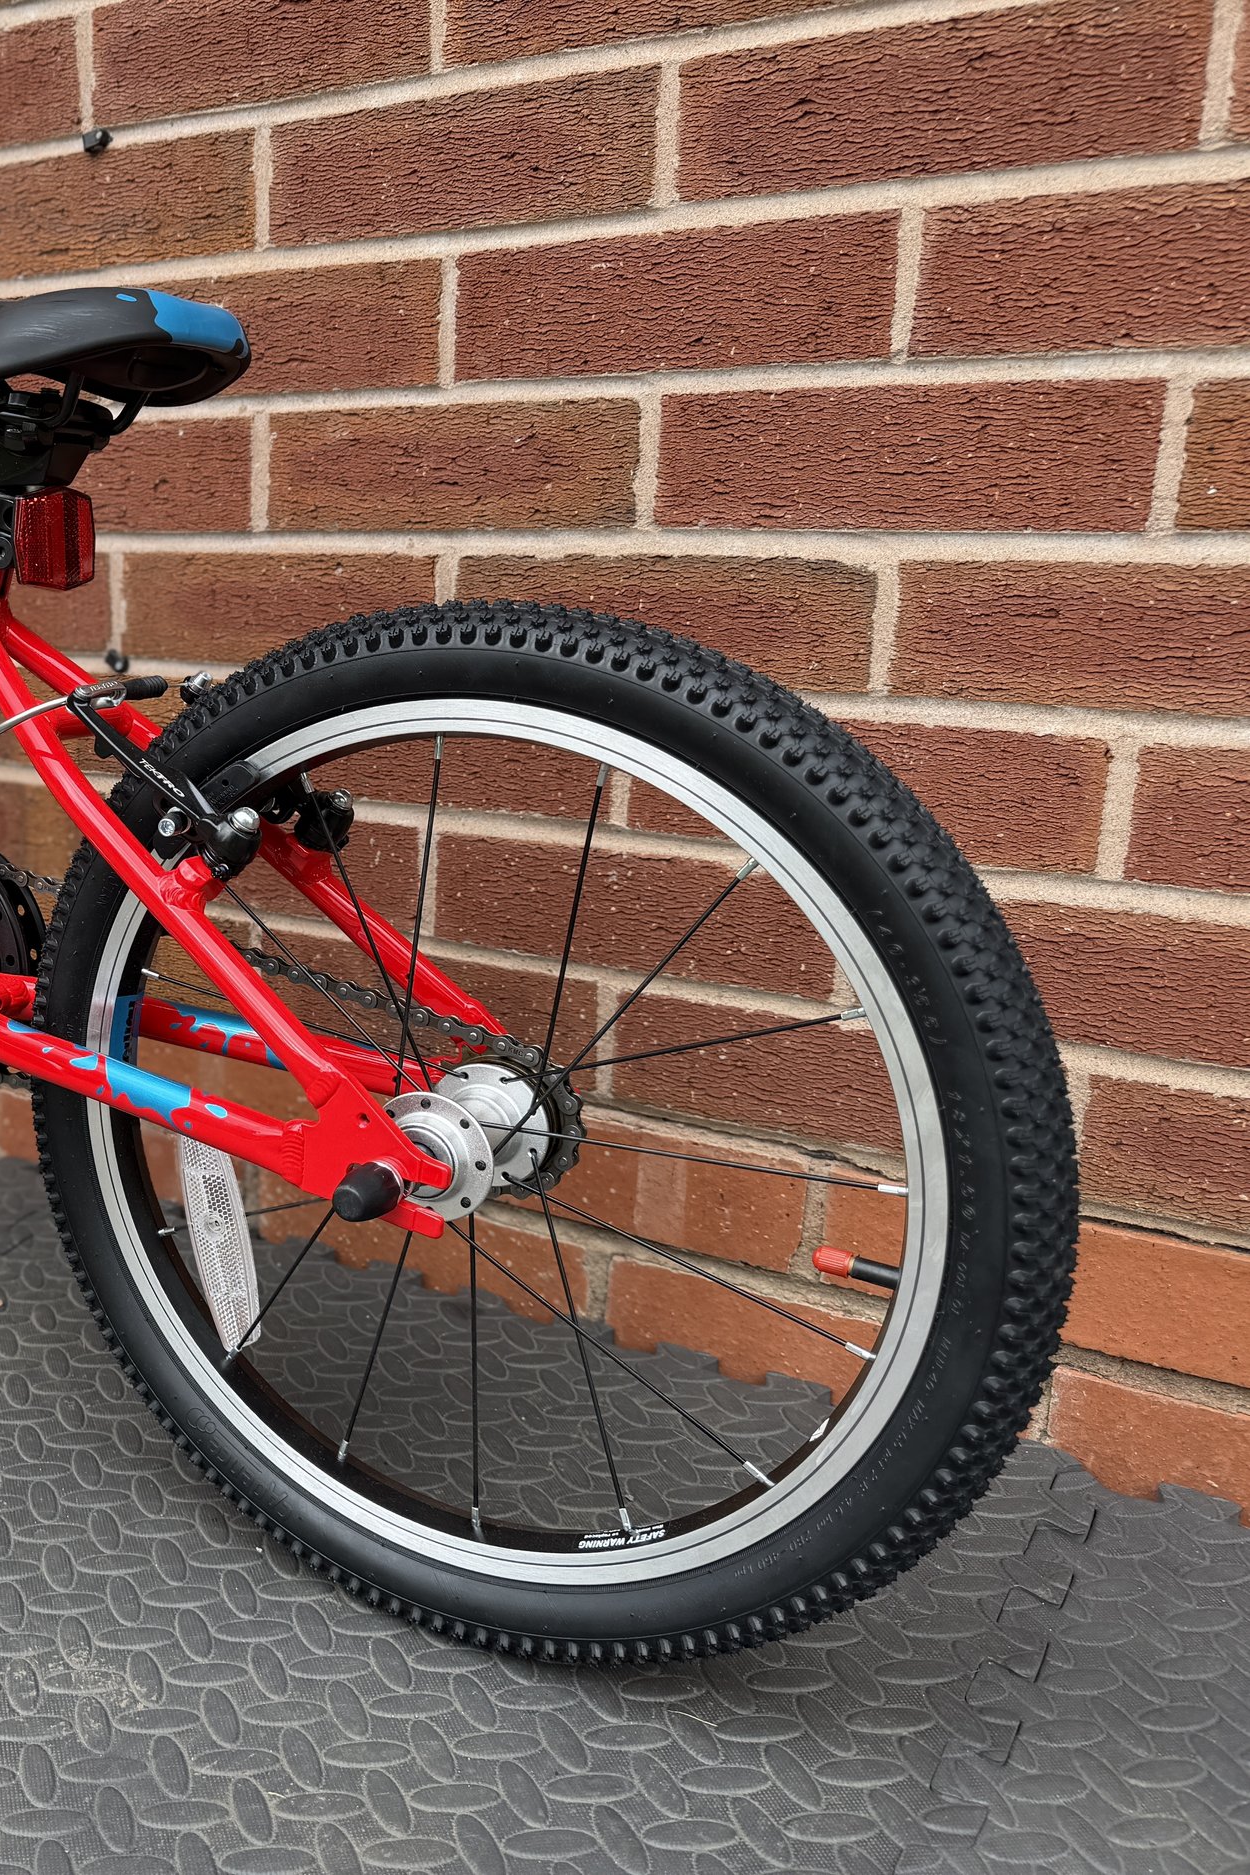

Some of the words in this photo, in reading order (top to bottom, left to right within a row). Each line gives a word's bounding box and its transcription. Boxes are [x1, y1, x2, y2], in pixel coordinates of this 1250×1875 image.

[138, 758, 186, 798] TEKTRO
[578, 1537, 625, 1548] WARNING
[626, 1529, 665, 1544] SAFETY
